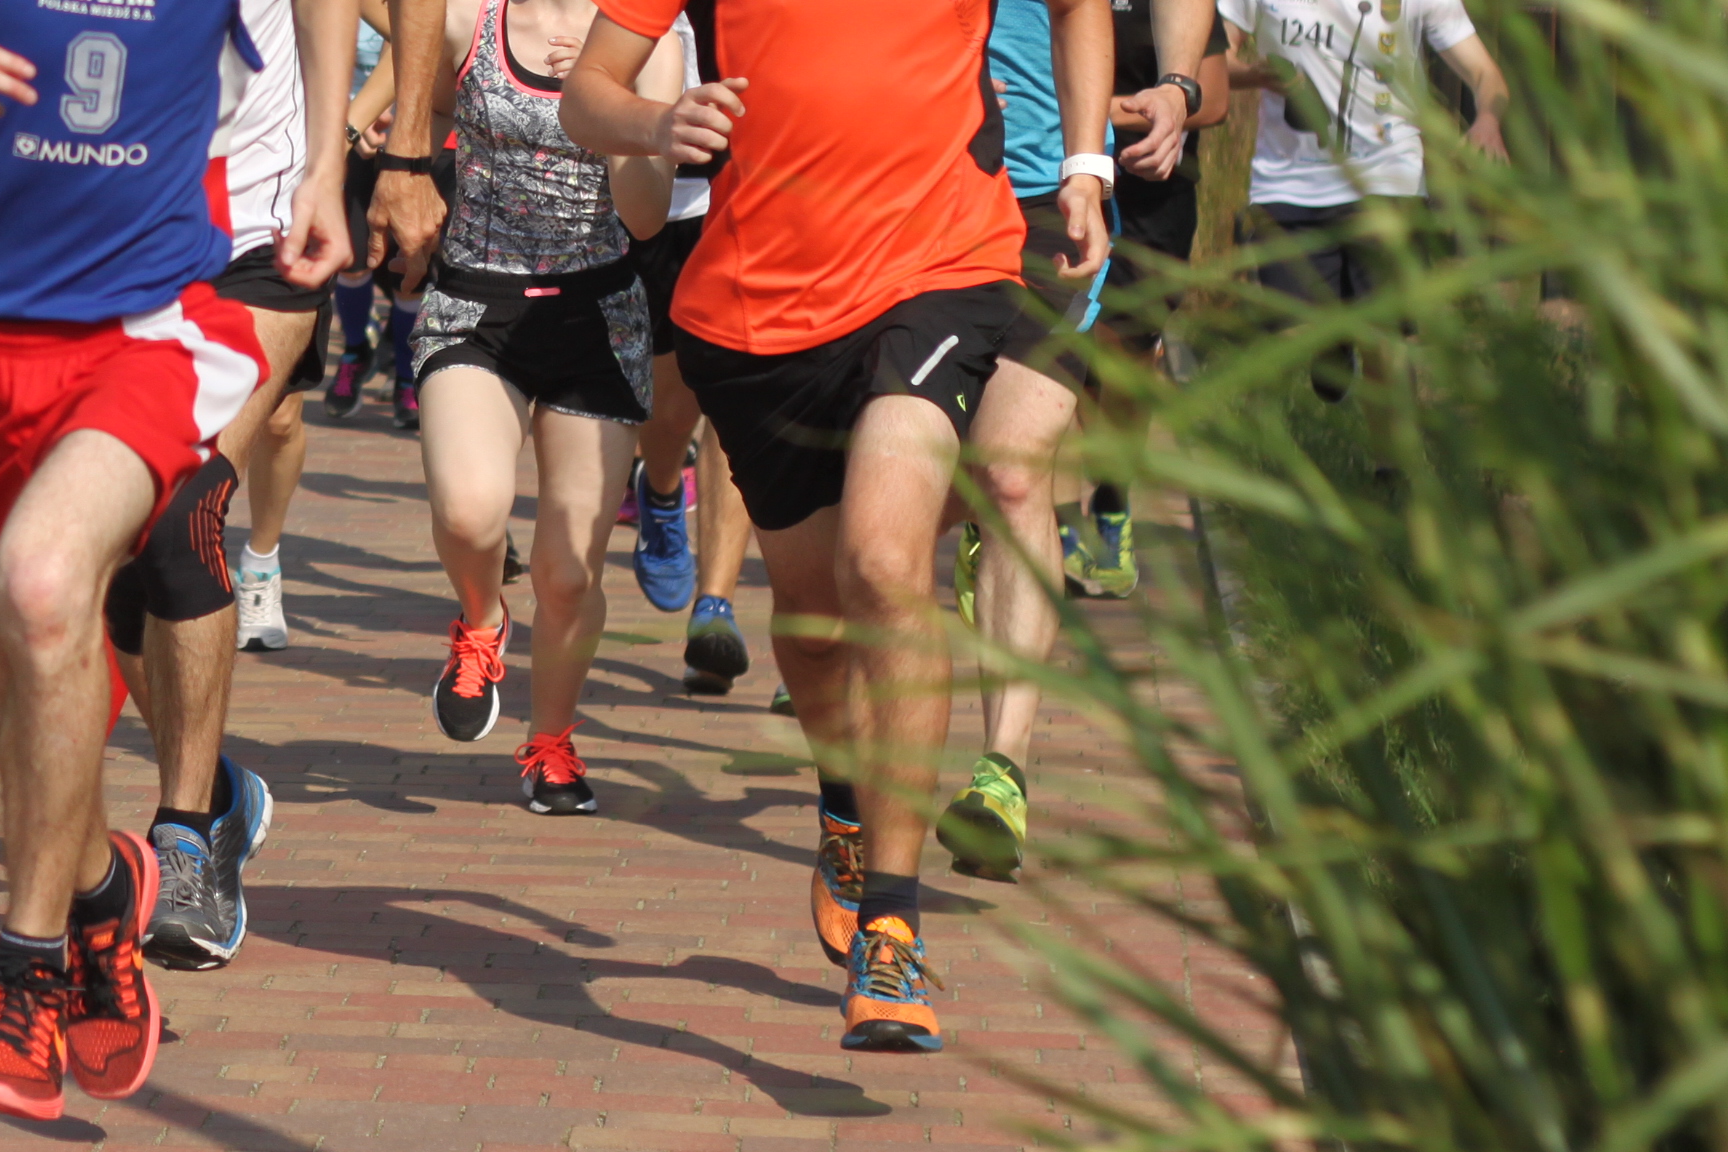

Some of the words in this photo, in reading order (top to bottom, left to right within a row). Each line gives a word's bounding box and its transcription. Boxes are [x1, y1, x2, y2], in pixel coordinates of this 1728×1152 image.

[1281, 18, 1334, 49] 1241
[60, 31, 127, 134] 9
[39, 139, 149, 166] MUNDO
